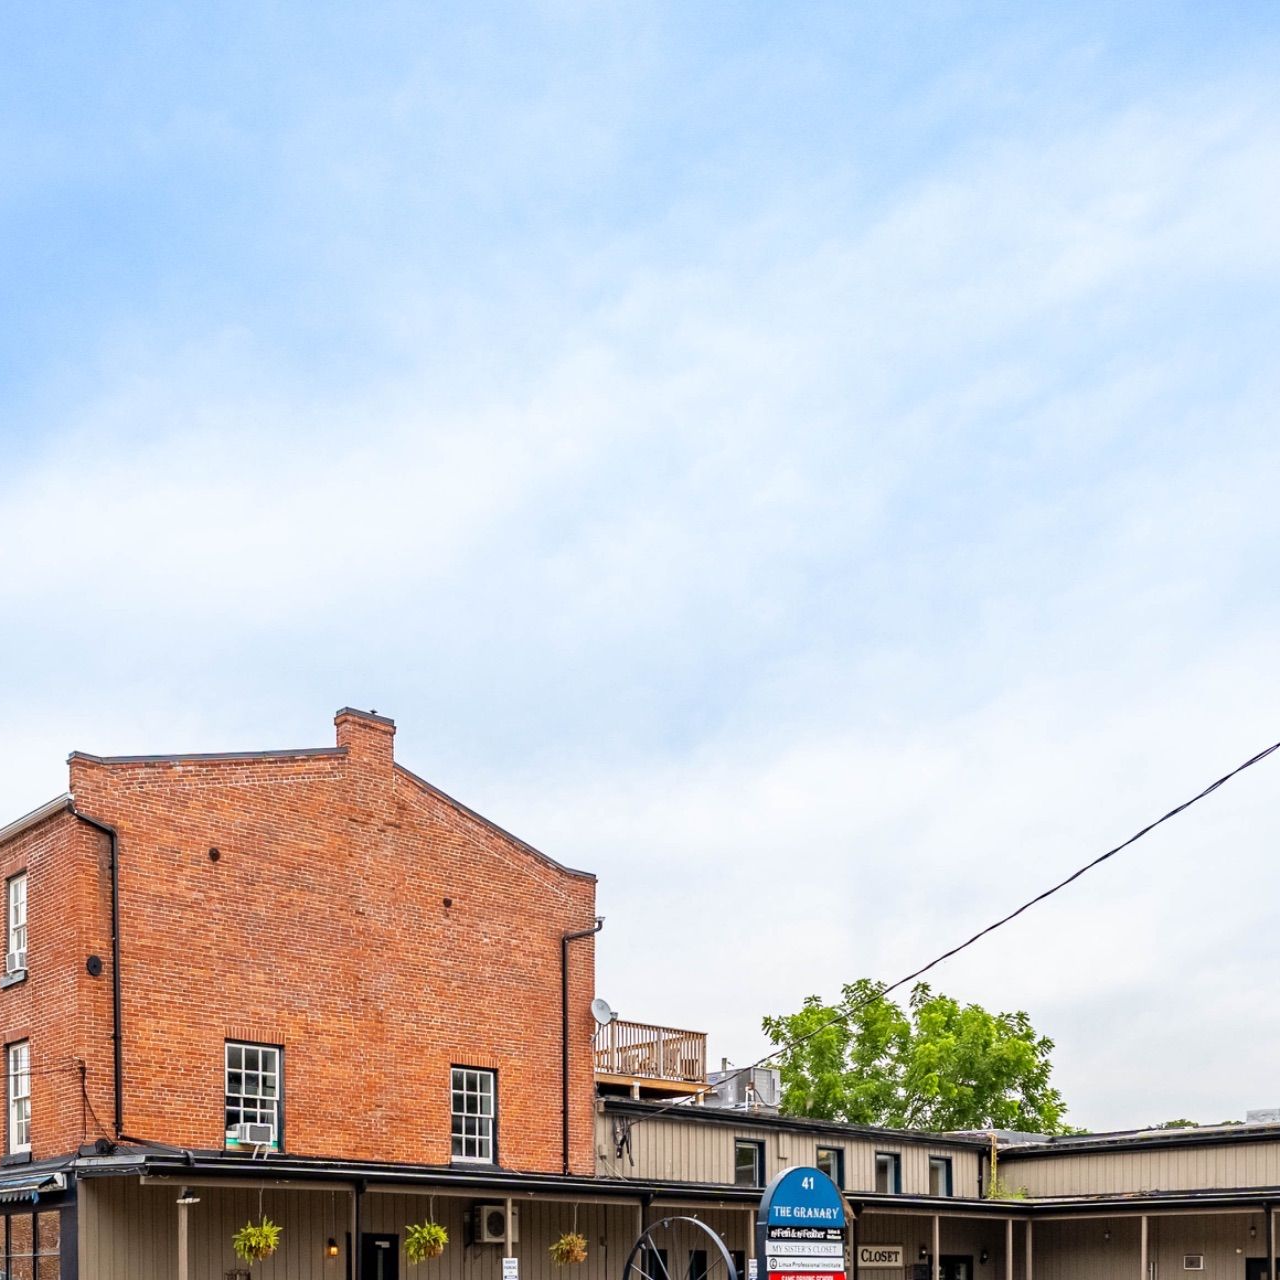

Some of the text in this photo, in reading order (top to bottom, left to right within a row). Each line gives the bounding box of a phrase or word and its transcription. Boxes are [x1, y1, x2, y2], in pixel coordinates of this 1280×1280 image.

[801, 1177, 814, 1190] 41
[773, 1206, 839, 1219] THE GRANARY
[784, 1245, 811, 1253] SISTER'S
[812, 1245, 837, 1253] CLOSET
